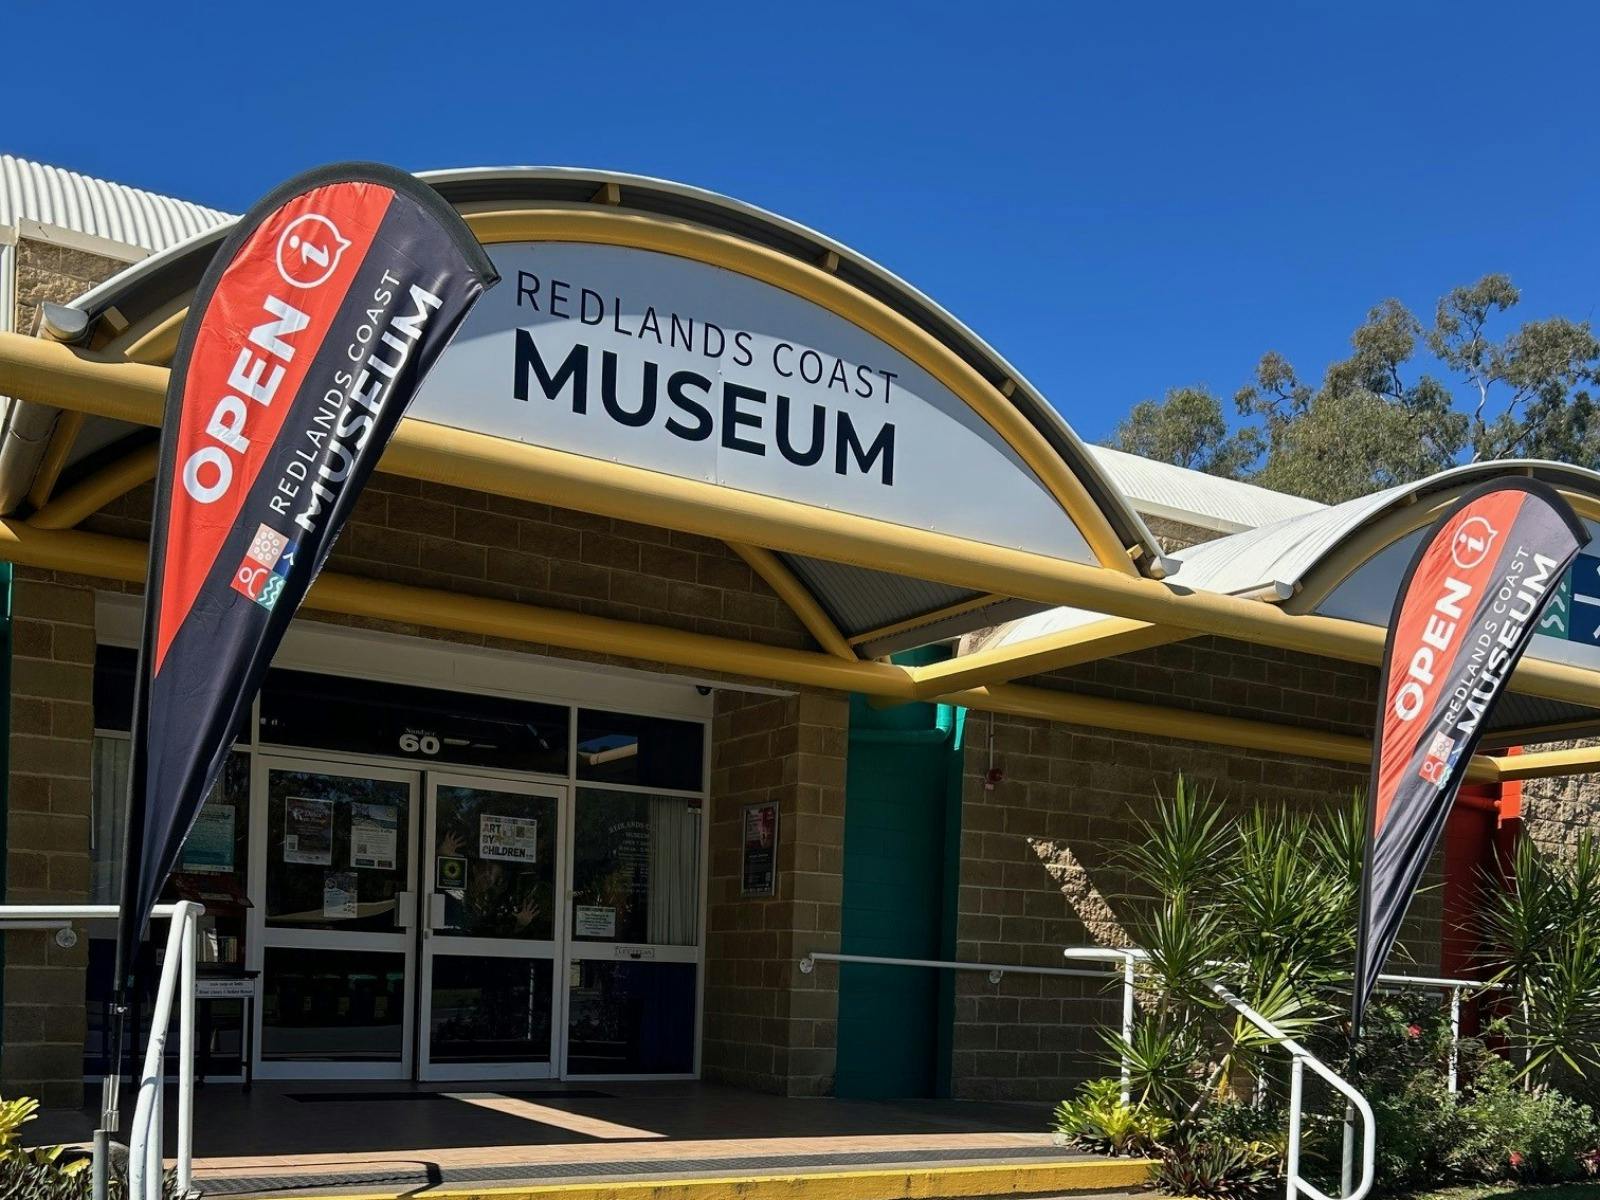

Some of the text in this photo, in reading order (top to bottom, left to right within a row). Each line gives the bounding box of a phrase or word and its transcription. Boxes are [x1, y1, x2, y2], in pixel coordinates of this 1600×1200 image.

[183, 294, 312, 504] OPEN
[269, 268, 400, 515] REDLANDS COAST
[294, 284, 443, 533] MUSEUM
[513, 327, 896, 486] MUSEUM
[517, 270, 898, 404] REDLANDS COAST
[1395, 576, 1472, 722] OPEN
[1444, 546, 1529, 725] REDLANDS COAST
[1456, 552, 1558, 735] MUSEUM
[399, 733, 440, 755] 60
[482, 823, 501, 834] ART
[482, 834, 495, 845] BY
[482, 845, 526, 858] CHILDREN
